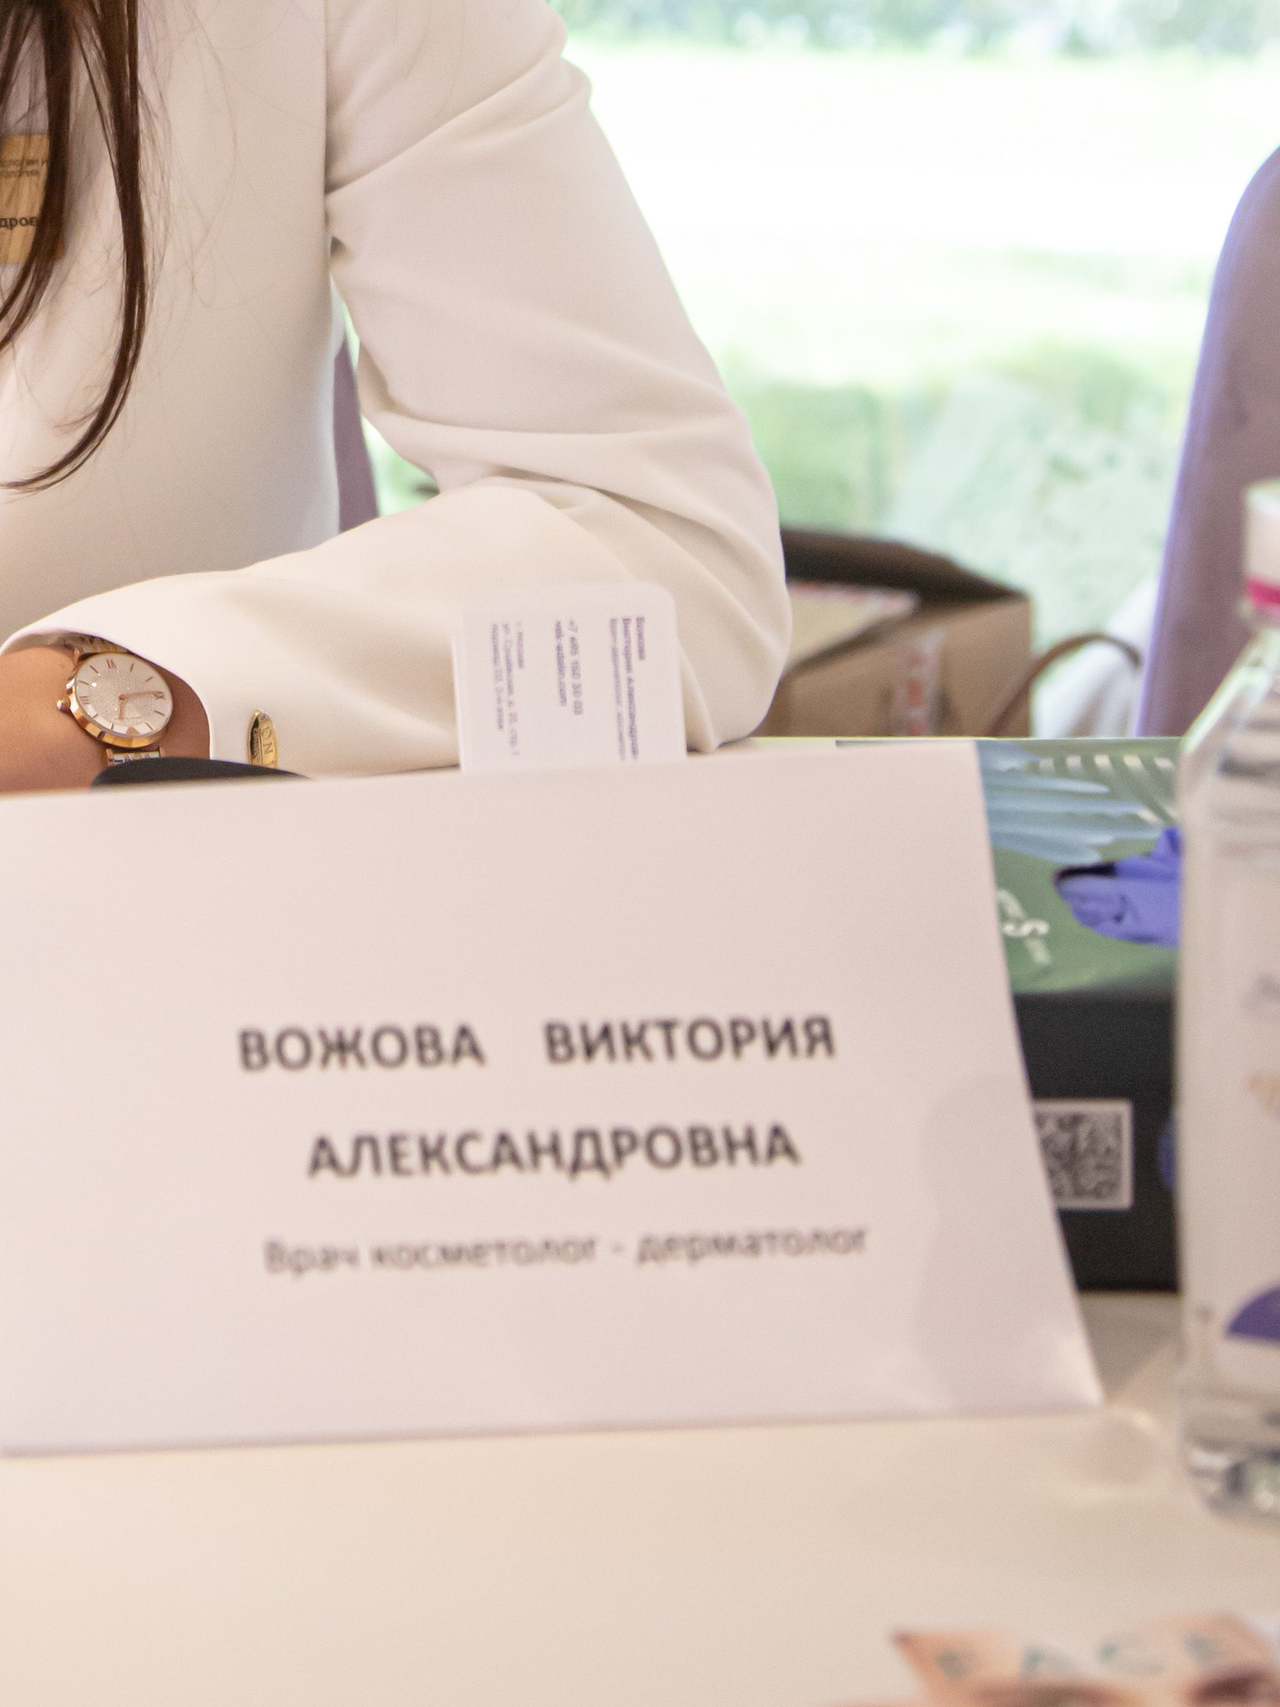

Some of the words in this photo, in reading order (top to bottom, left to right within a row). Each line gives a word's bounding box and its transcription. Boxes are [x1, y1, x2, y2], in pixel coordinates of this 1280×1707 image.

[239, 1023, 488, 1075] ВОЖОВА
[545, 1014, 835, 1064] ВИКТОРИЯ
[307, 1122, 801, 1182] АЛЕКСАНДРОВНА
[264, 1239, 360, 1280] Врач
[372, 1233, 597, 1269] косметолог
[635, 1225, 868, 1269] дерматолог
